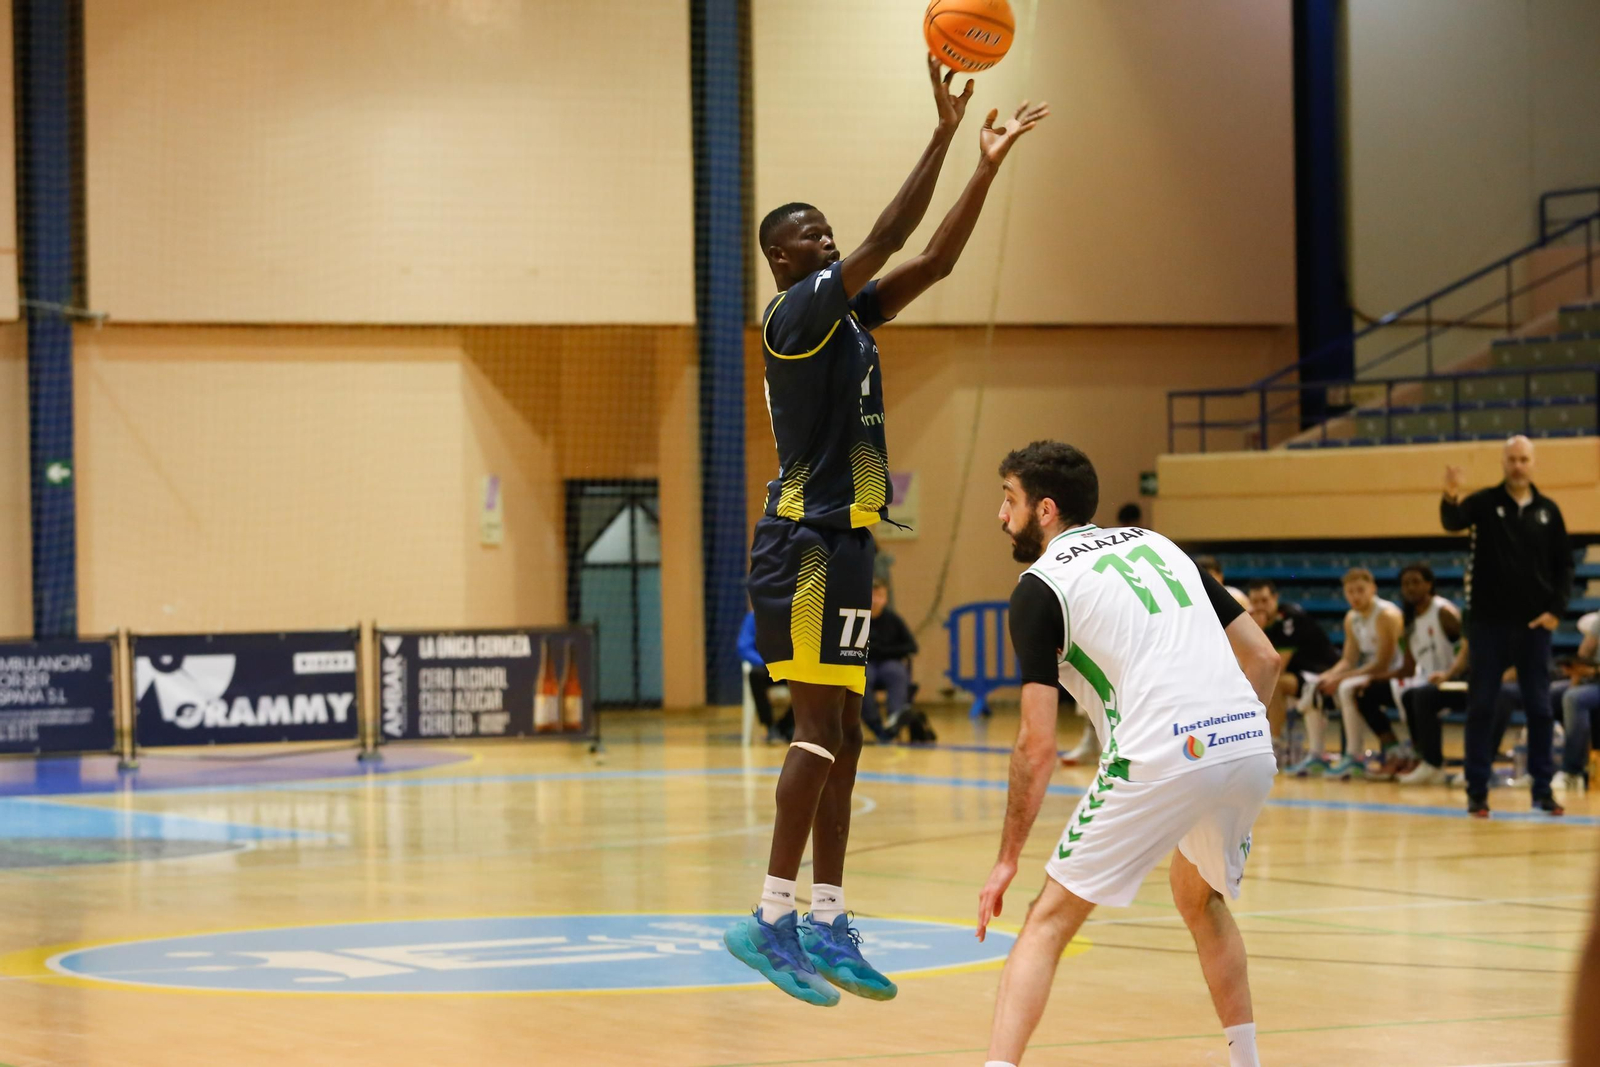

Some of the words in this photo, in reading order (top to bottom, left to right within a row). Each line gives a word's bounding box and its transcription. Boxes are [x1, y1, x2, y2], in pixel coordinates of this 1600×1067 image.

[1055, 528, 1148, 564] SALAZAR
[1092, 544, 1193, 615] 11
[839, 608, 871, 648] 77
[418, 637, 436, 659] LA
[475, 634, 531, 658] CERVEZA
[419, 667, 453, 690] CERO
[455, 666, 508, 690] ALCOHOL
[383, 654, 403, 737] AMBAR
[419, 690, 453, 712] CERO
[175, 692, 354, 729] GRAMMY
[419, 712, 453, 735] CERO
[1173, 711, 1256, 736] Instalaciones
[1207, 729, 1264, 747] Zornotza
